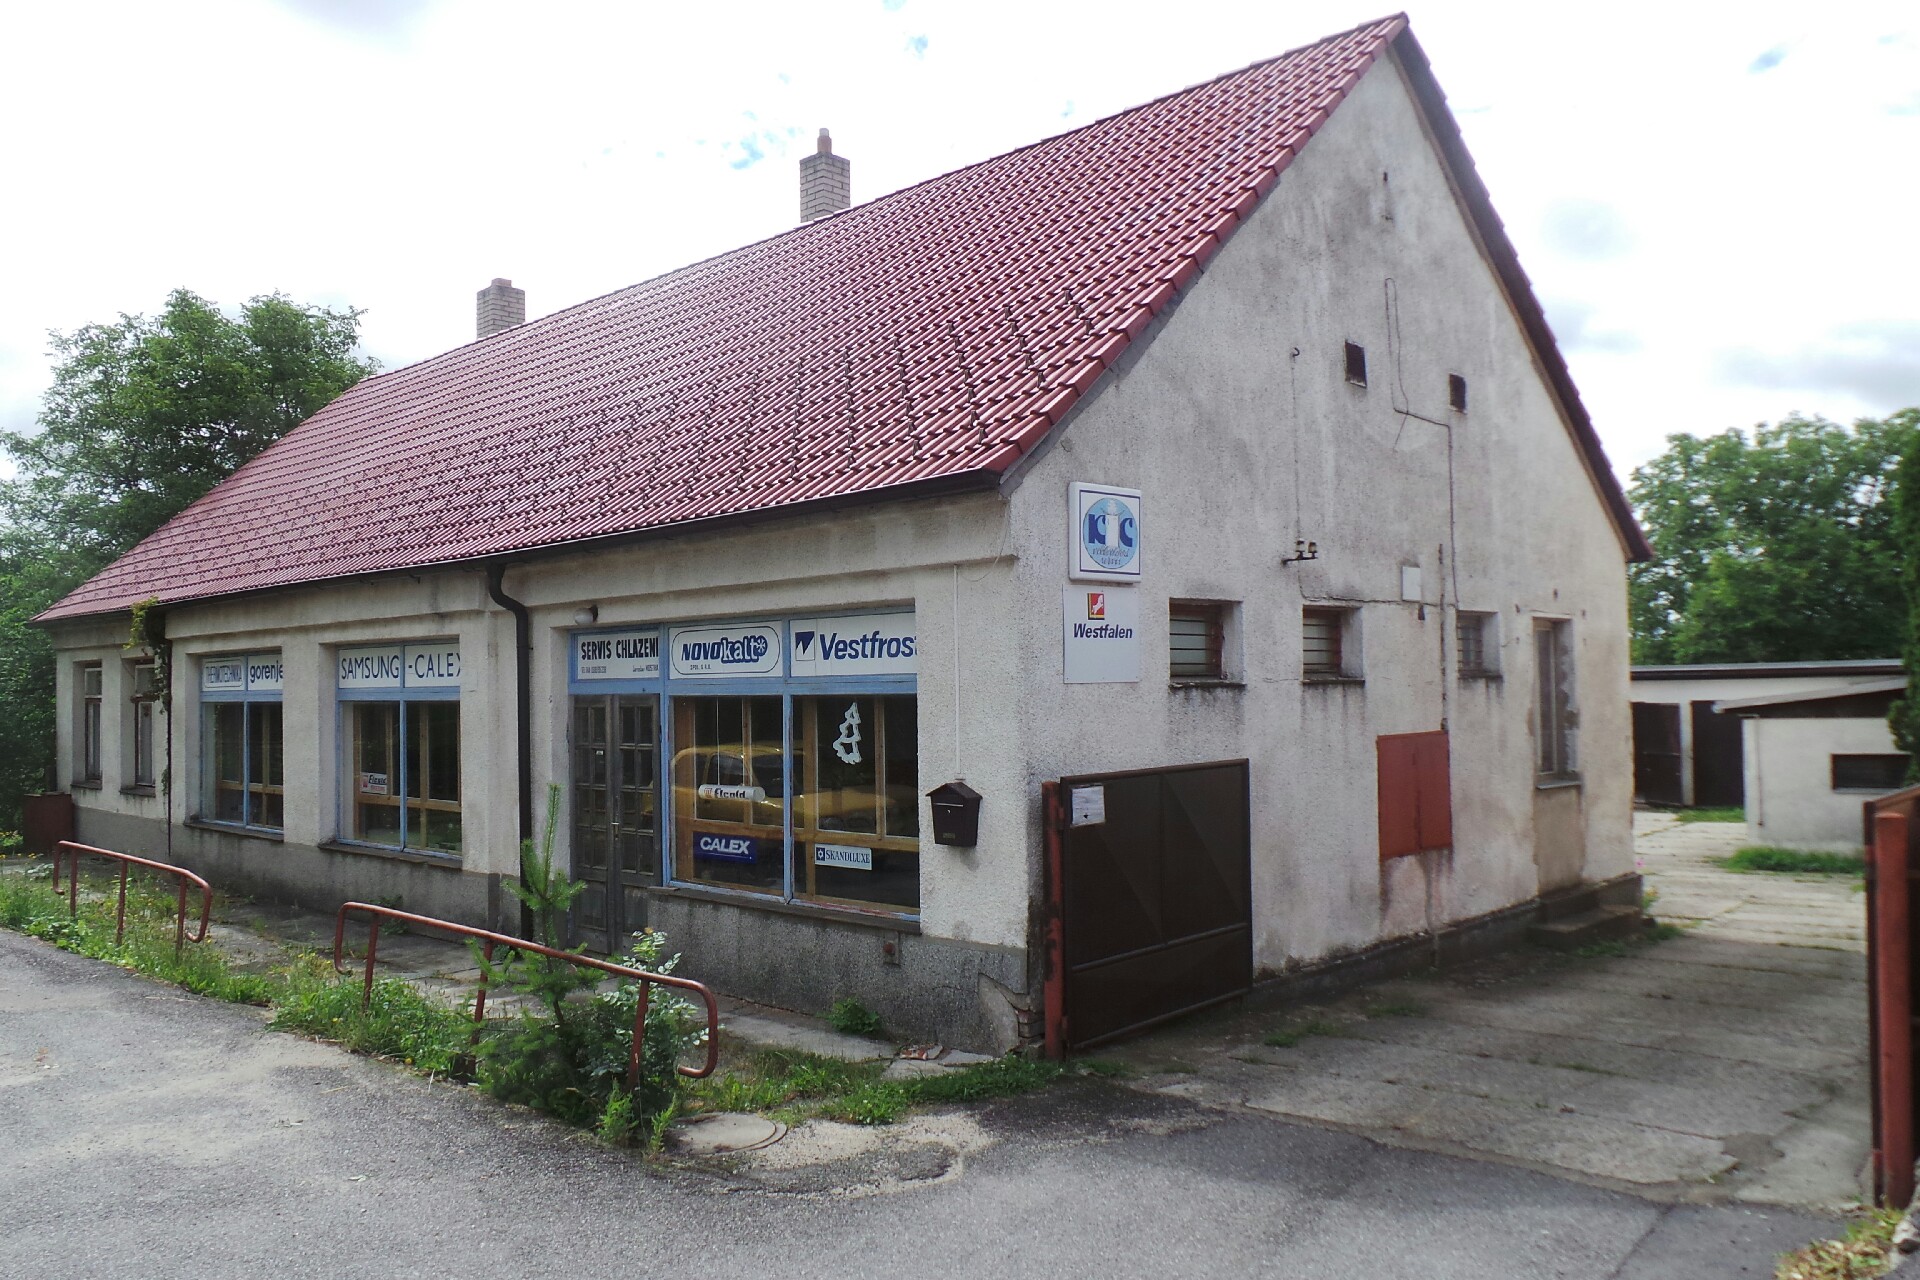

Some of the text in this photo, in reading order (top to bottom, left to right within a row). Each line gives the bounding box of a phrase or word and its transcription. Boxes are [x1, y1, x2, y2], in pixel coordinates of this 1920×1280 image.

[1073, 623, 1133, 639] Westfalen
[581, 640, 612, 660] SERVIS
[249, 660, 283, 683] gorenje
[341, 655, 399, 679] SAMSUNG
[700, 836, 751, 855] CALEX
[825, 849, 871, 864] SKANDILUXE
